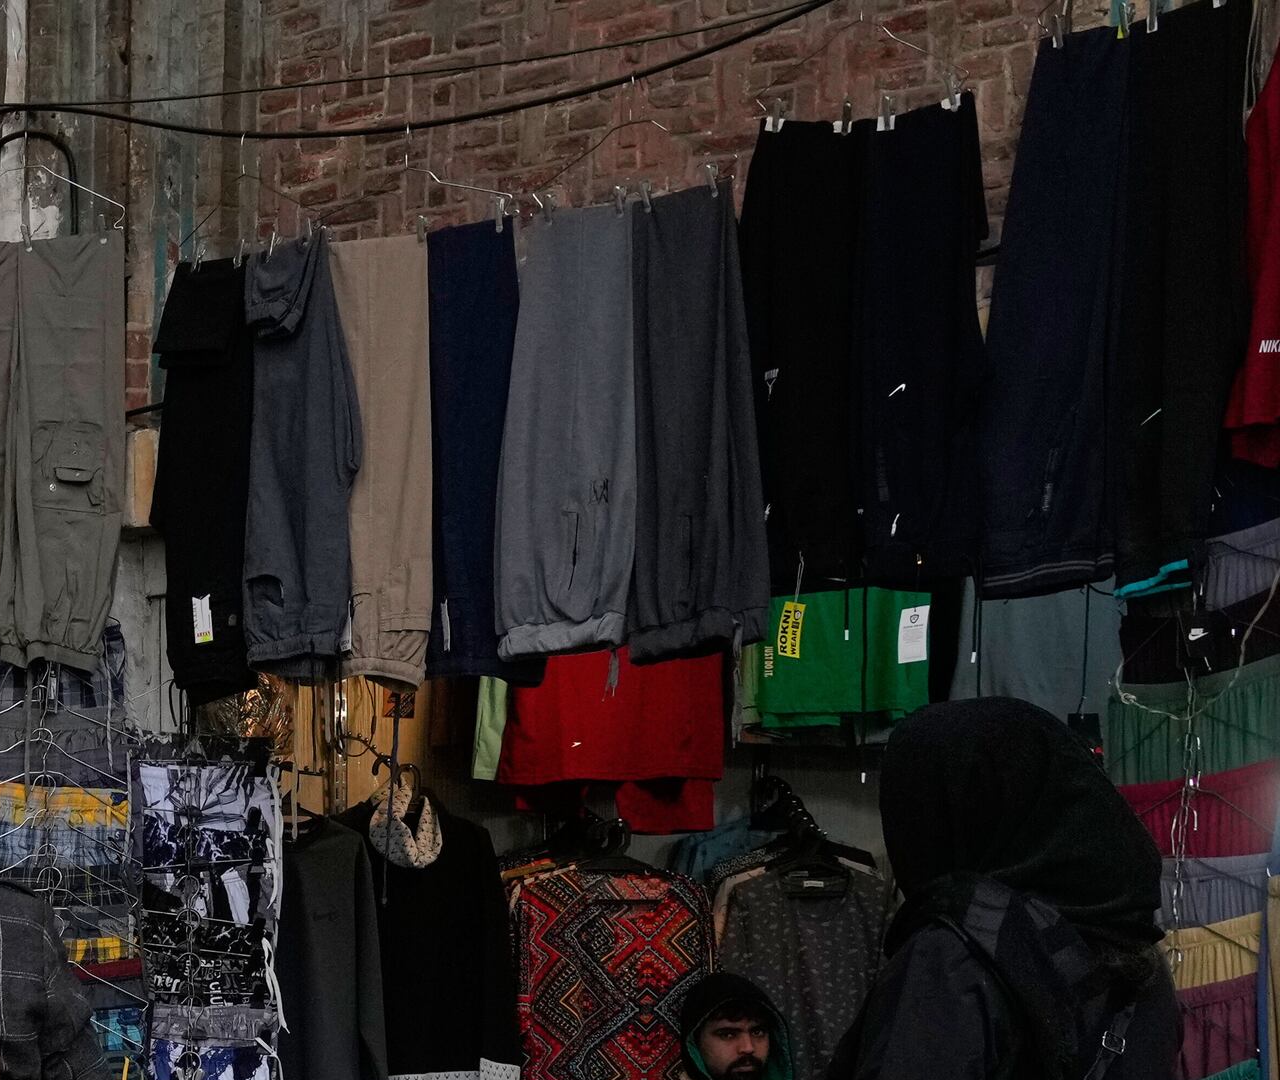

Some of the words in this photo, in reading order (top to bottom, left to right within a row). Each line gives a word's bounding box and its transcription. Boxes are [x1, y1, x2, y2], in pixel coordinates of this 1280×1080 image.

[779, 609, 792, 654] ROKNI
[790, 629, 799, 655] WEAR
[764, 646, 774, 660] JUST
[764, 660, 774, 669] DO
